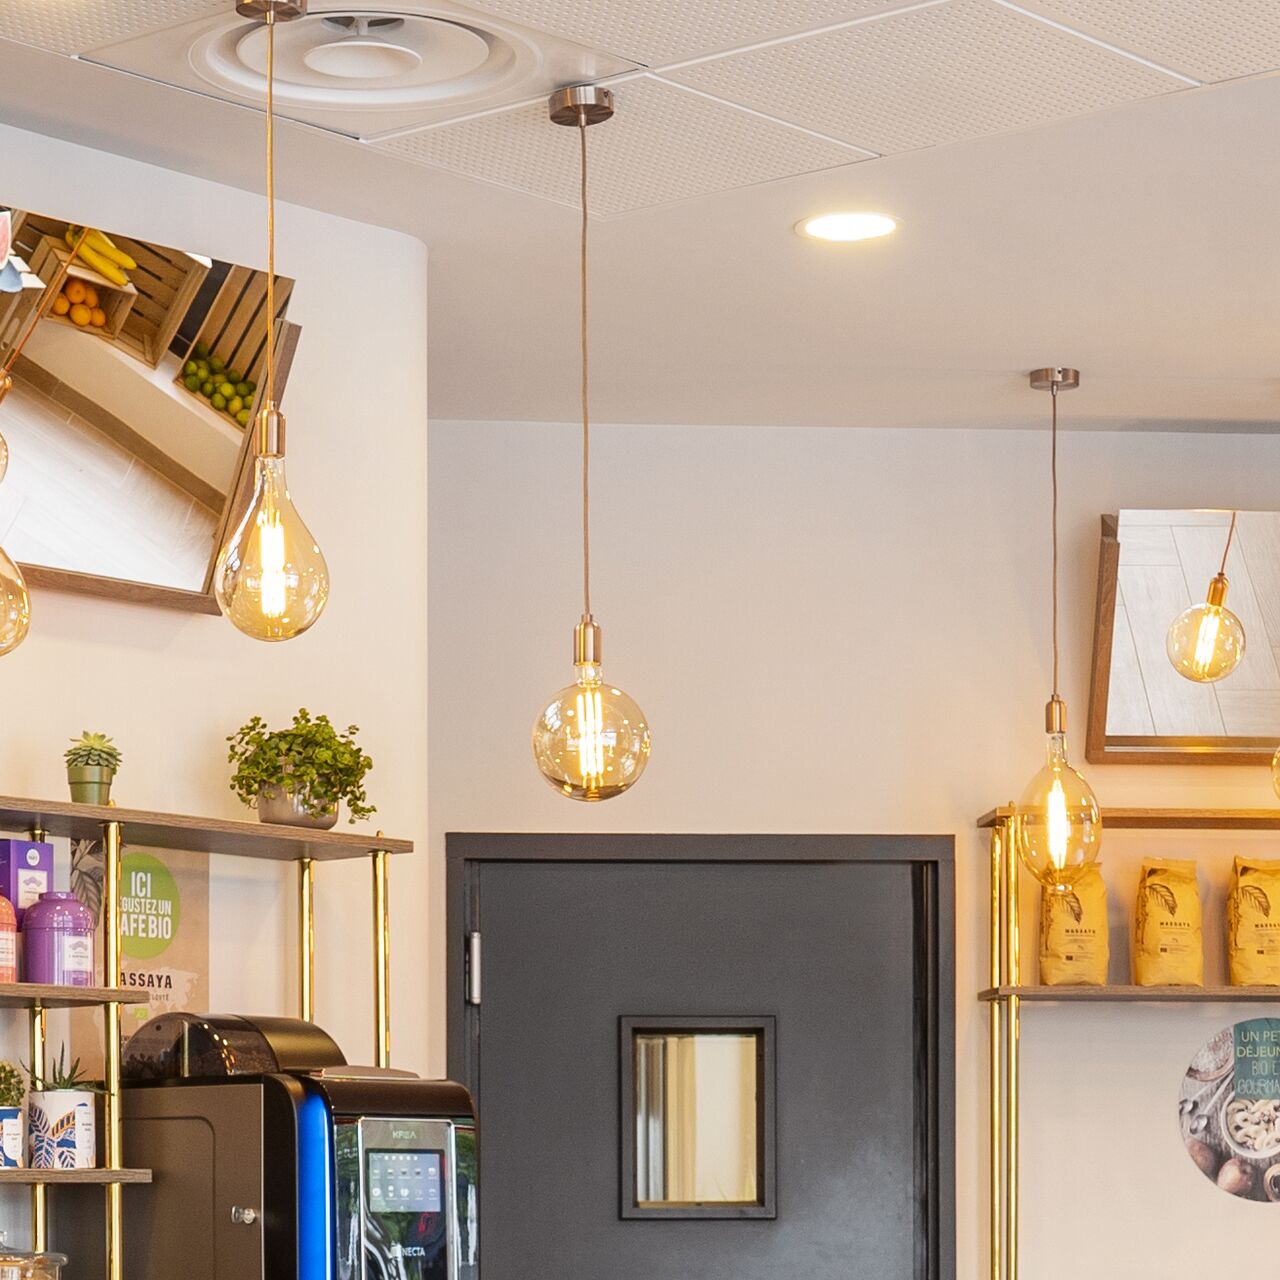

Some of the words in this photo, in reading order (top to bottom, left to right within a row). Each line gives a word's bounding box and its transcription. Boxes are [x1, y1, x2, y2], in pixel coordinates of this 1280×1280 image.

[131, 871, 152, 898] ICI
[120, 896, 157, 915] GUSTEZ
[158, 899, 172, 916] UN
[120, 913, 147, 938] AFE
[148, 915, 172, 940] BIO
[120, 972, 173, 989] ASSAYA
[1241, 1031, 1260, 1042] UN
[1251, 1060, 1269, 1076] BIO
[402, 1247, 426, 1257] NECTA
